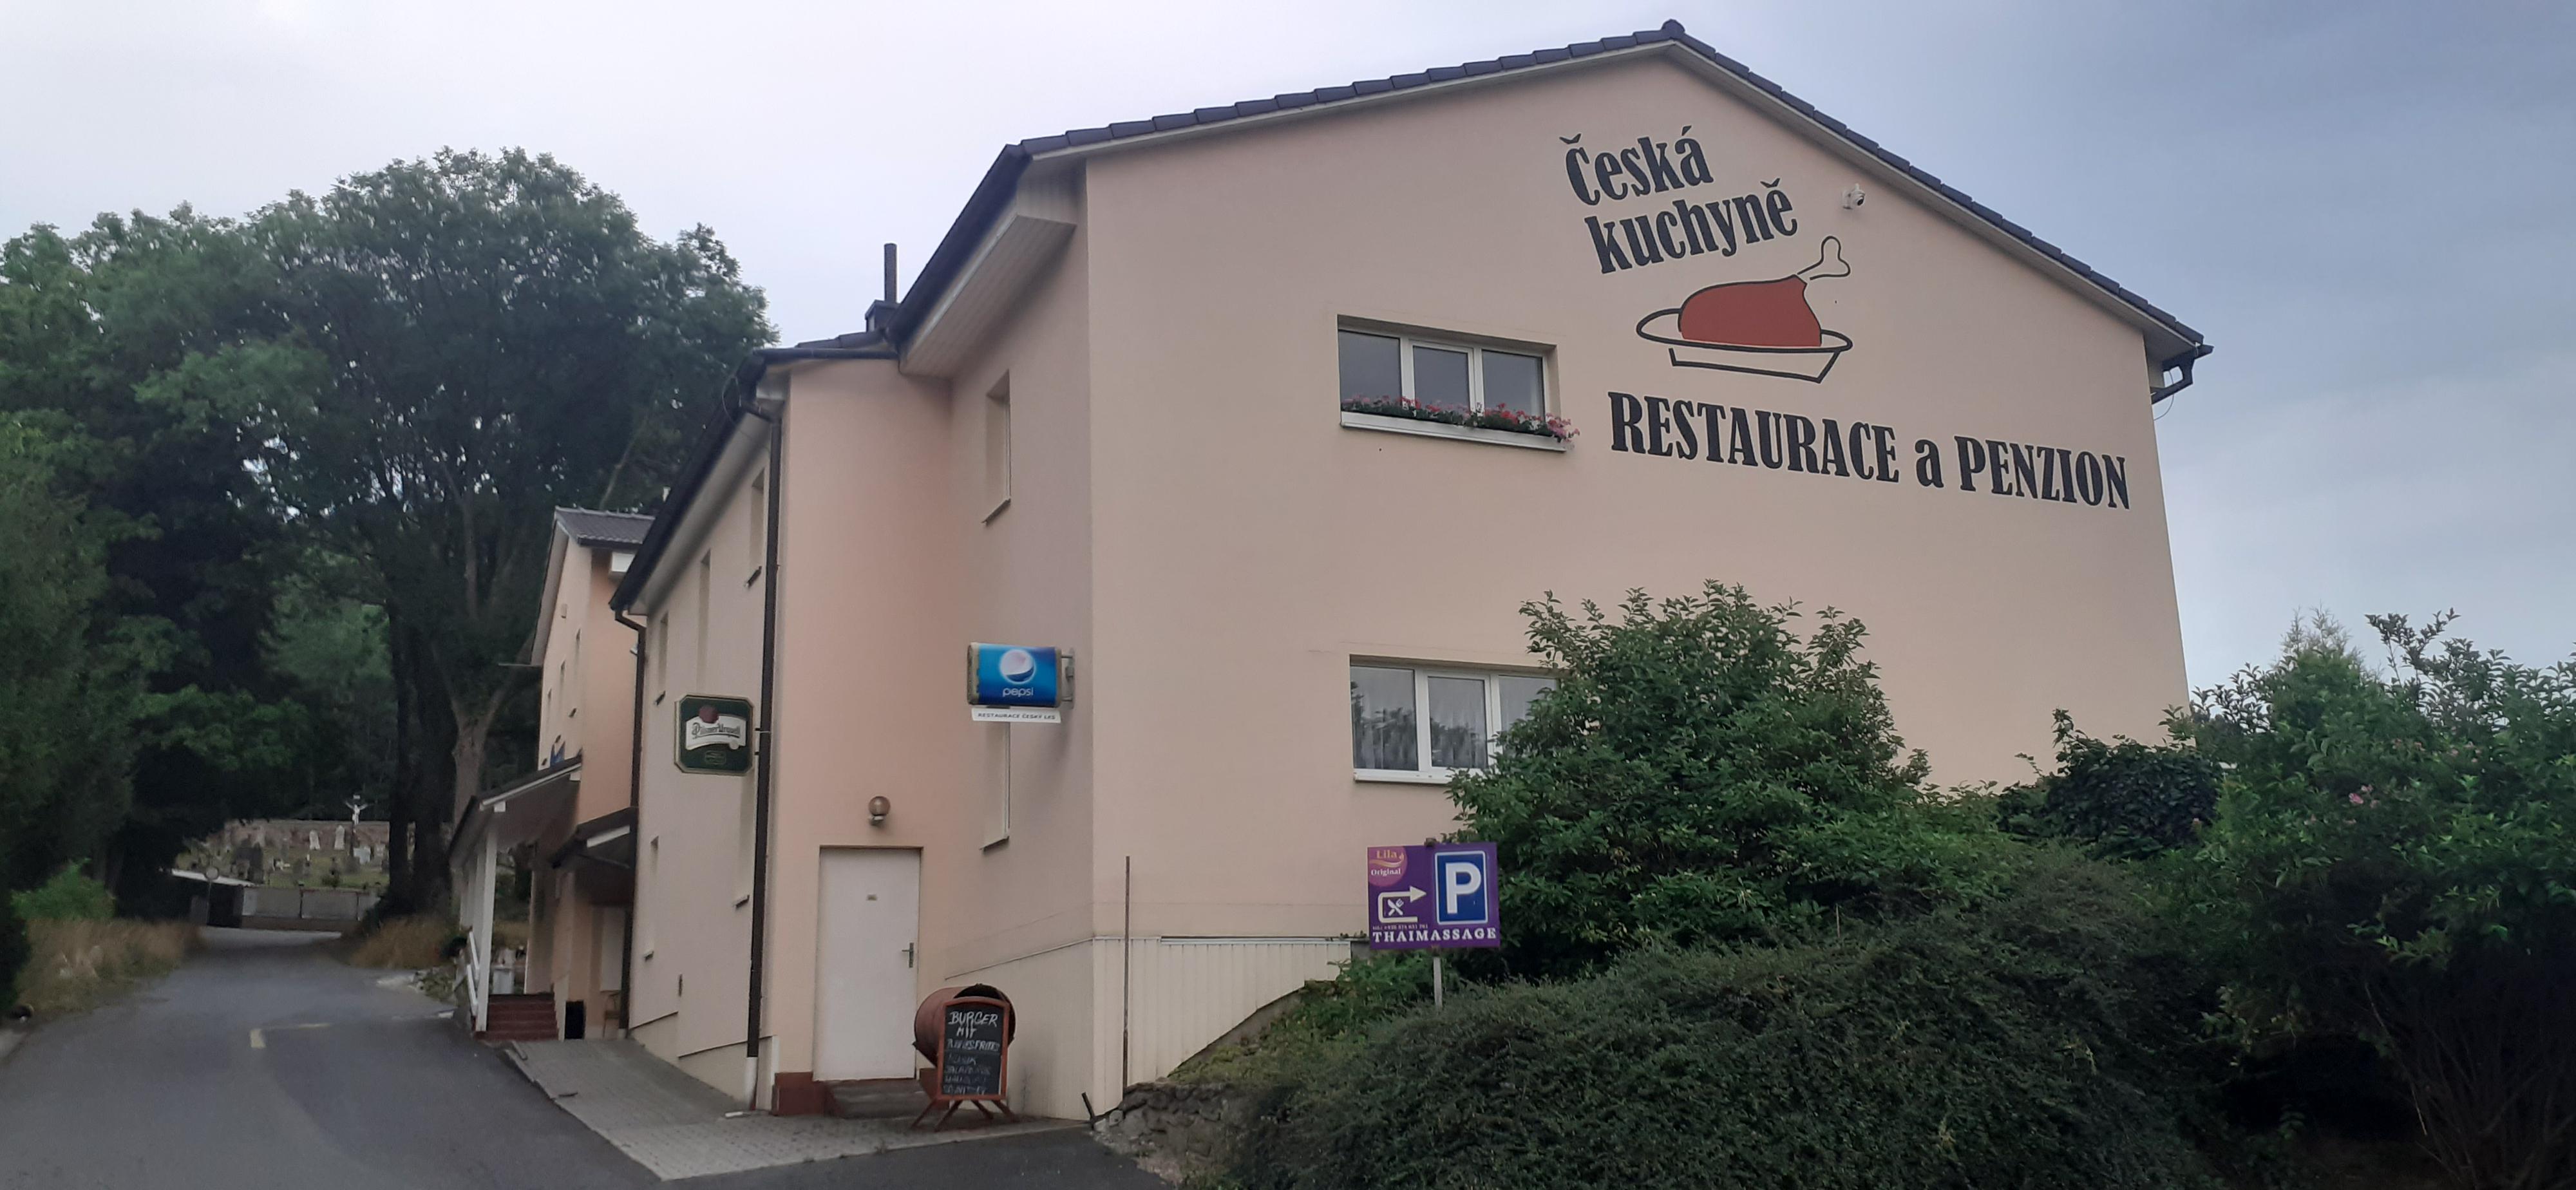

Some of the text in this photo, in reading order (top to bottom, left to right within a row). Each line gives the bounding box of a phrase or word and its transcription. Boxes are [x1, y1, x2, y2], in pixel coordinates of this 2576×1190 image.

[1559, 125, 1714, 206] Česká
[1584, 178, 1798, 274] kuchyně
[1607, 391, 2130, 510] RESTAURACE a PENZION
[1002, 687, 1034, 697] pepsi
[1376, 850, 1398, 859] Lila
[1370, 867, 1401, 876] Original
[1445, 862, 1482, 914] P
[1372, 927, 1497, 943] THAIMASSAGE
[948, 1011, 998, 1028] BURGER
